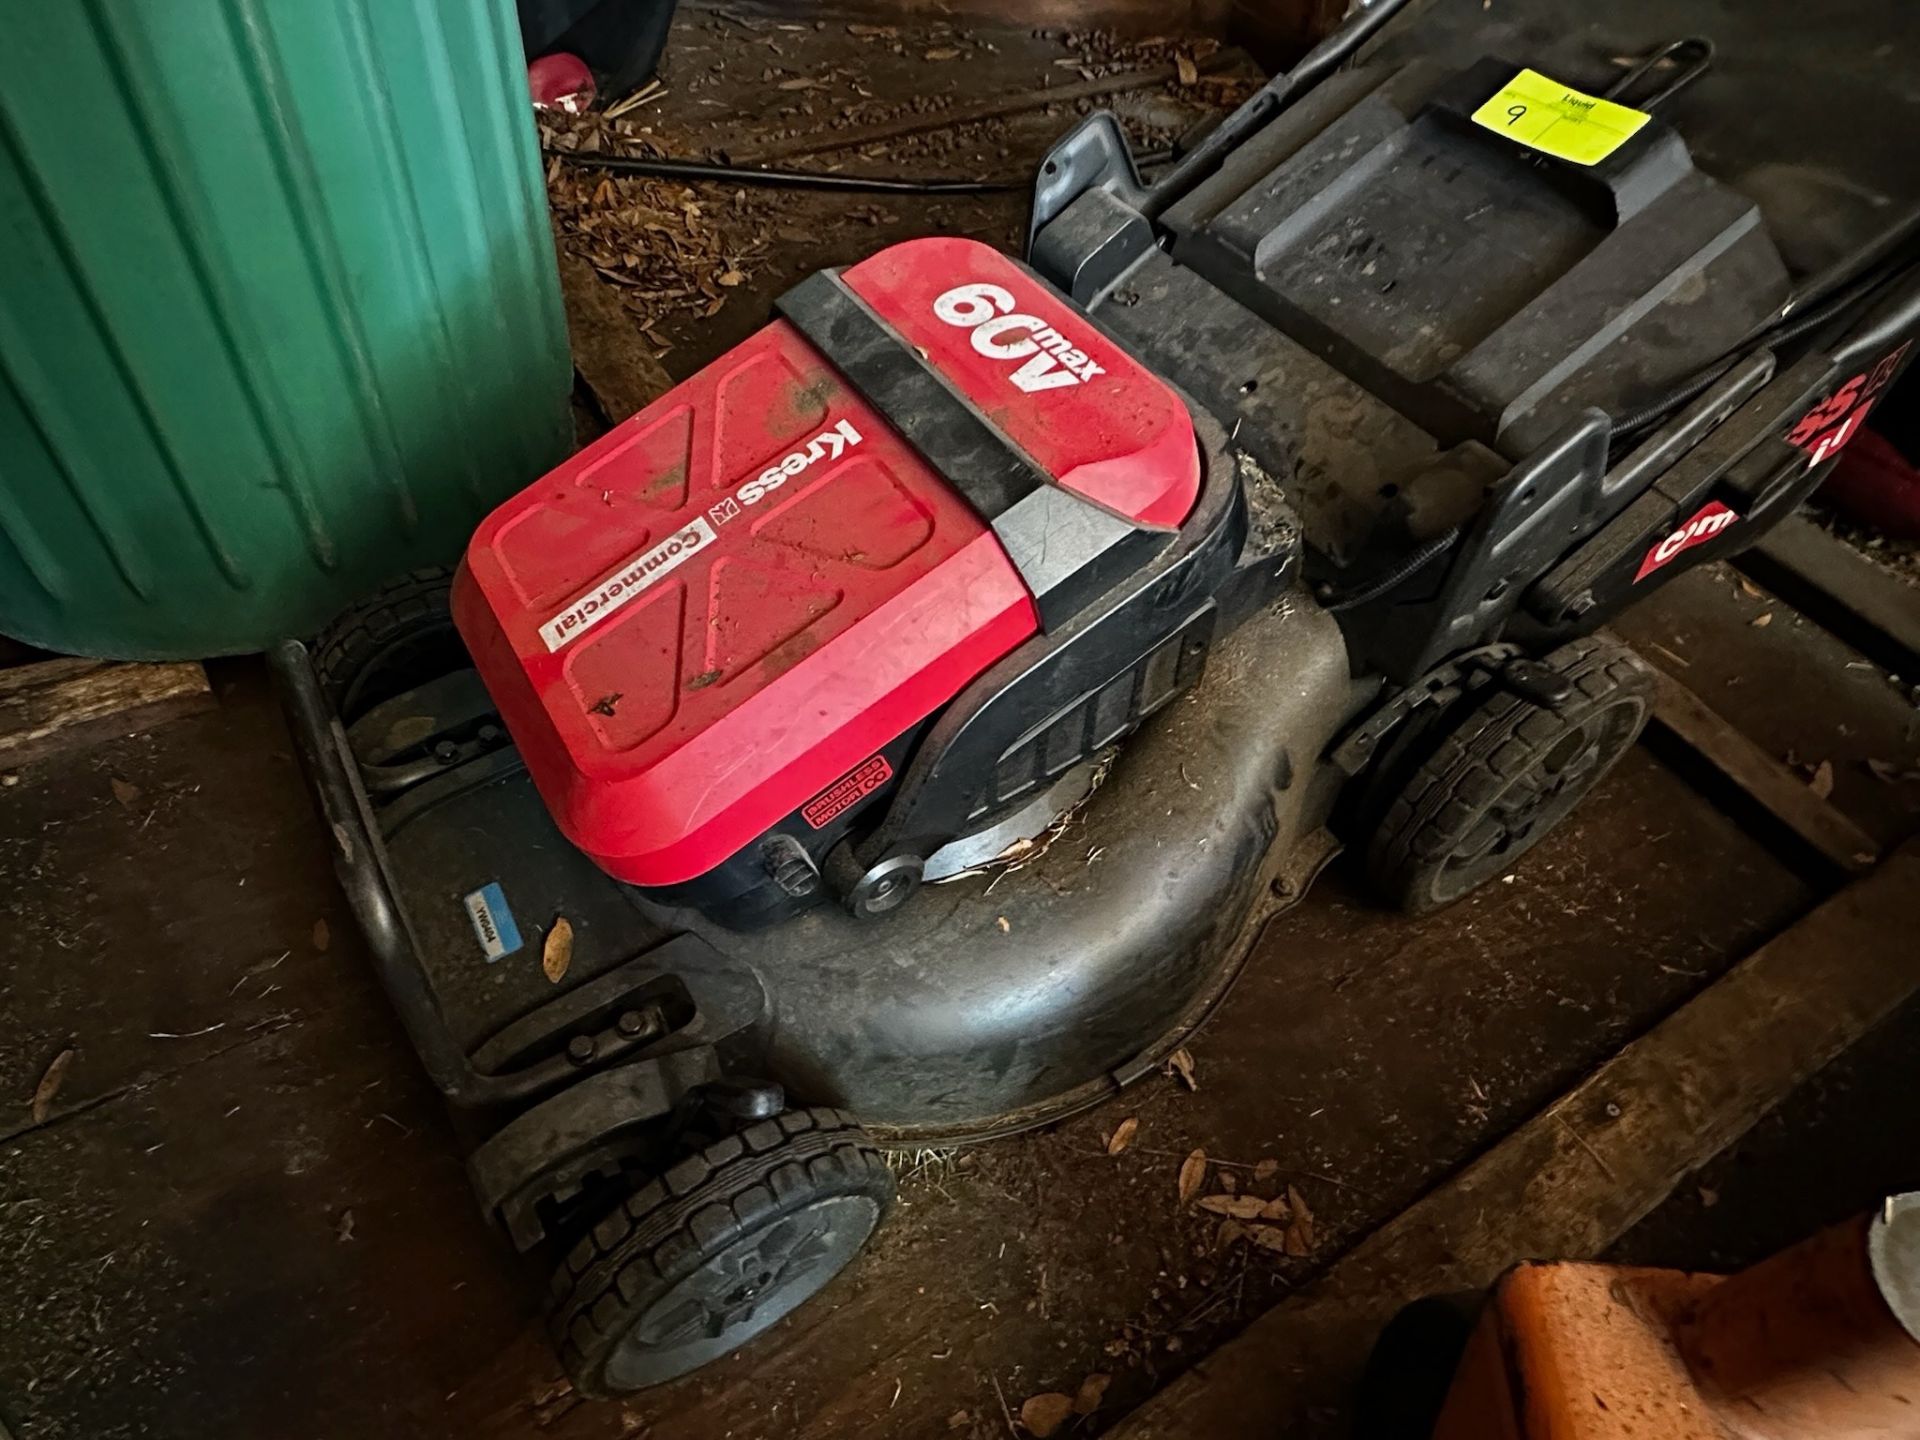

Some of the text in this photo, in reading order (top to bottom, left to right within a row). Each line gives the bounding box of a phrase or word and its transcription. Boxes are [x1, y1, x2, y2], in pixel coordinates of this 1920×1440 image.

[1507, 104, 1527, 126] 9
[1031, 326, 1107, 383] max
[554, 418, 863, 639] Kress Commercial
[807, 759, 882, 816] BRUSHLESS
[814, 788, 861, 825] MOTOR
